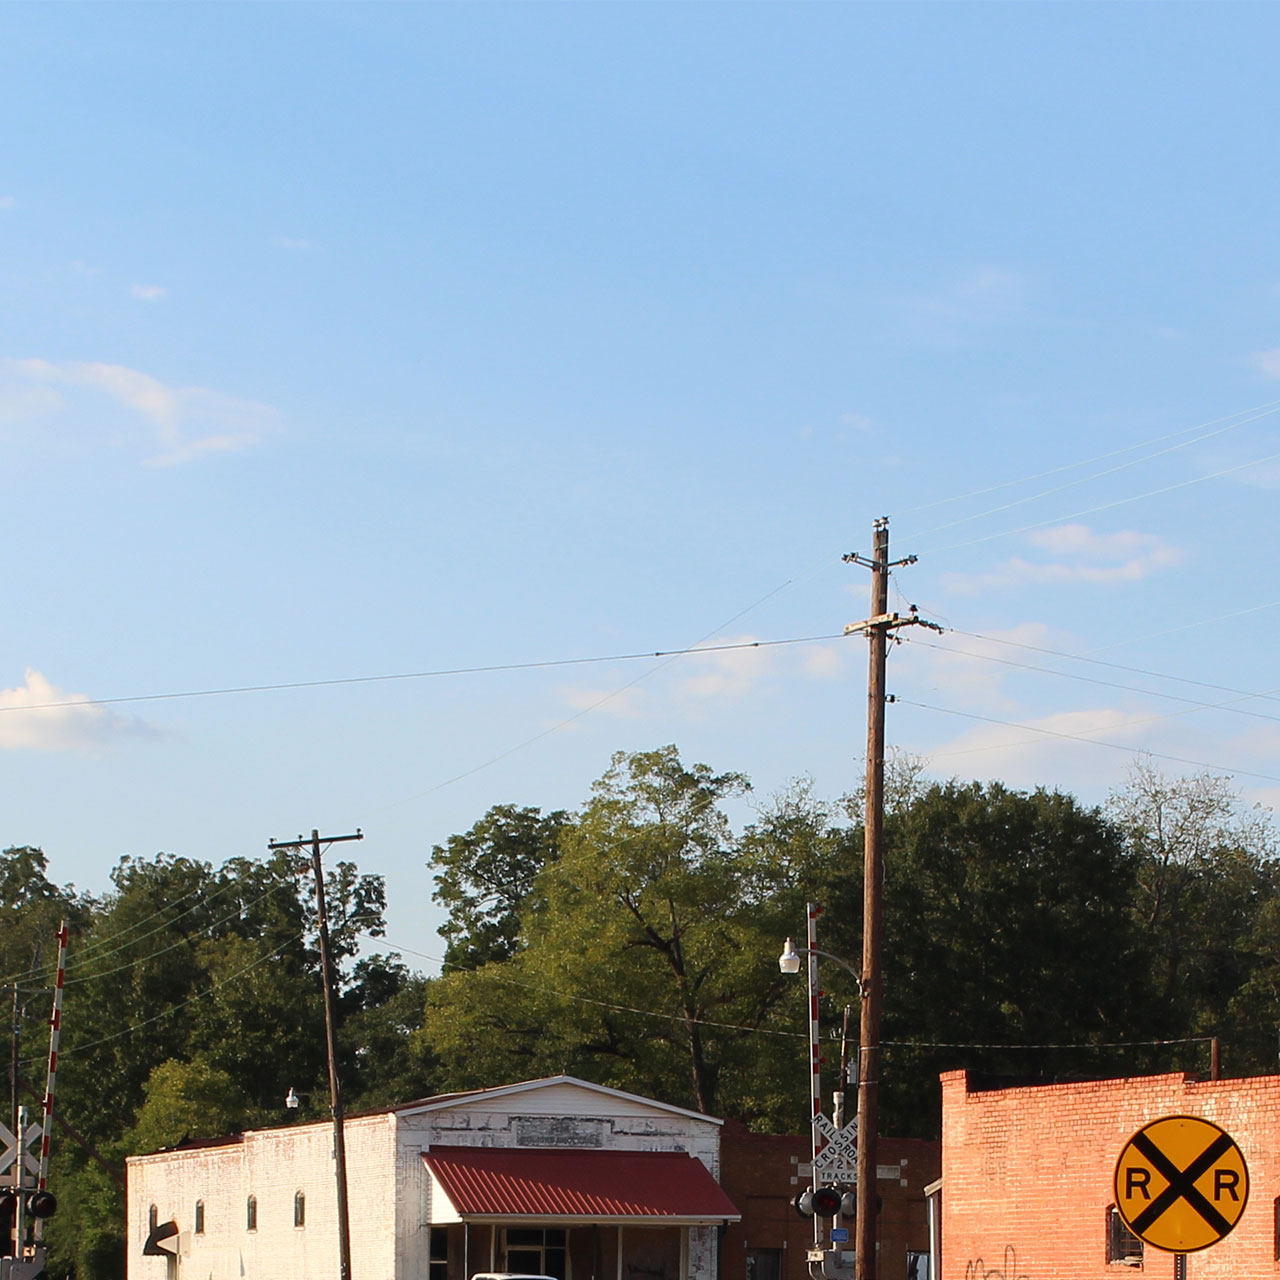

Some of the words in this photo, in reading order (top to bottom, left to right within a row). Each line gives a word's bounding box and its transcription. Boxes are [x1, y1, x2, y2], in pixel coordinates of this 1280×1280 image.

[814, 1115, 836, 1140] RAIL
[841, 1144, 858, 1165] ROA
[814, 1121, 858, 1169] CROSSIN
[821, 1172, 858, 1180] TRACKS
[836, 1160, 844, 1170] 2
[1125, 1167, 1151, 1200] R
[1213, 1169, 1240, 1202] R
